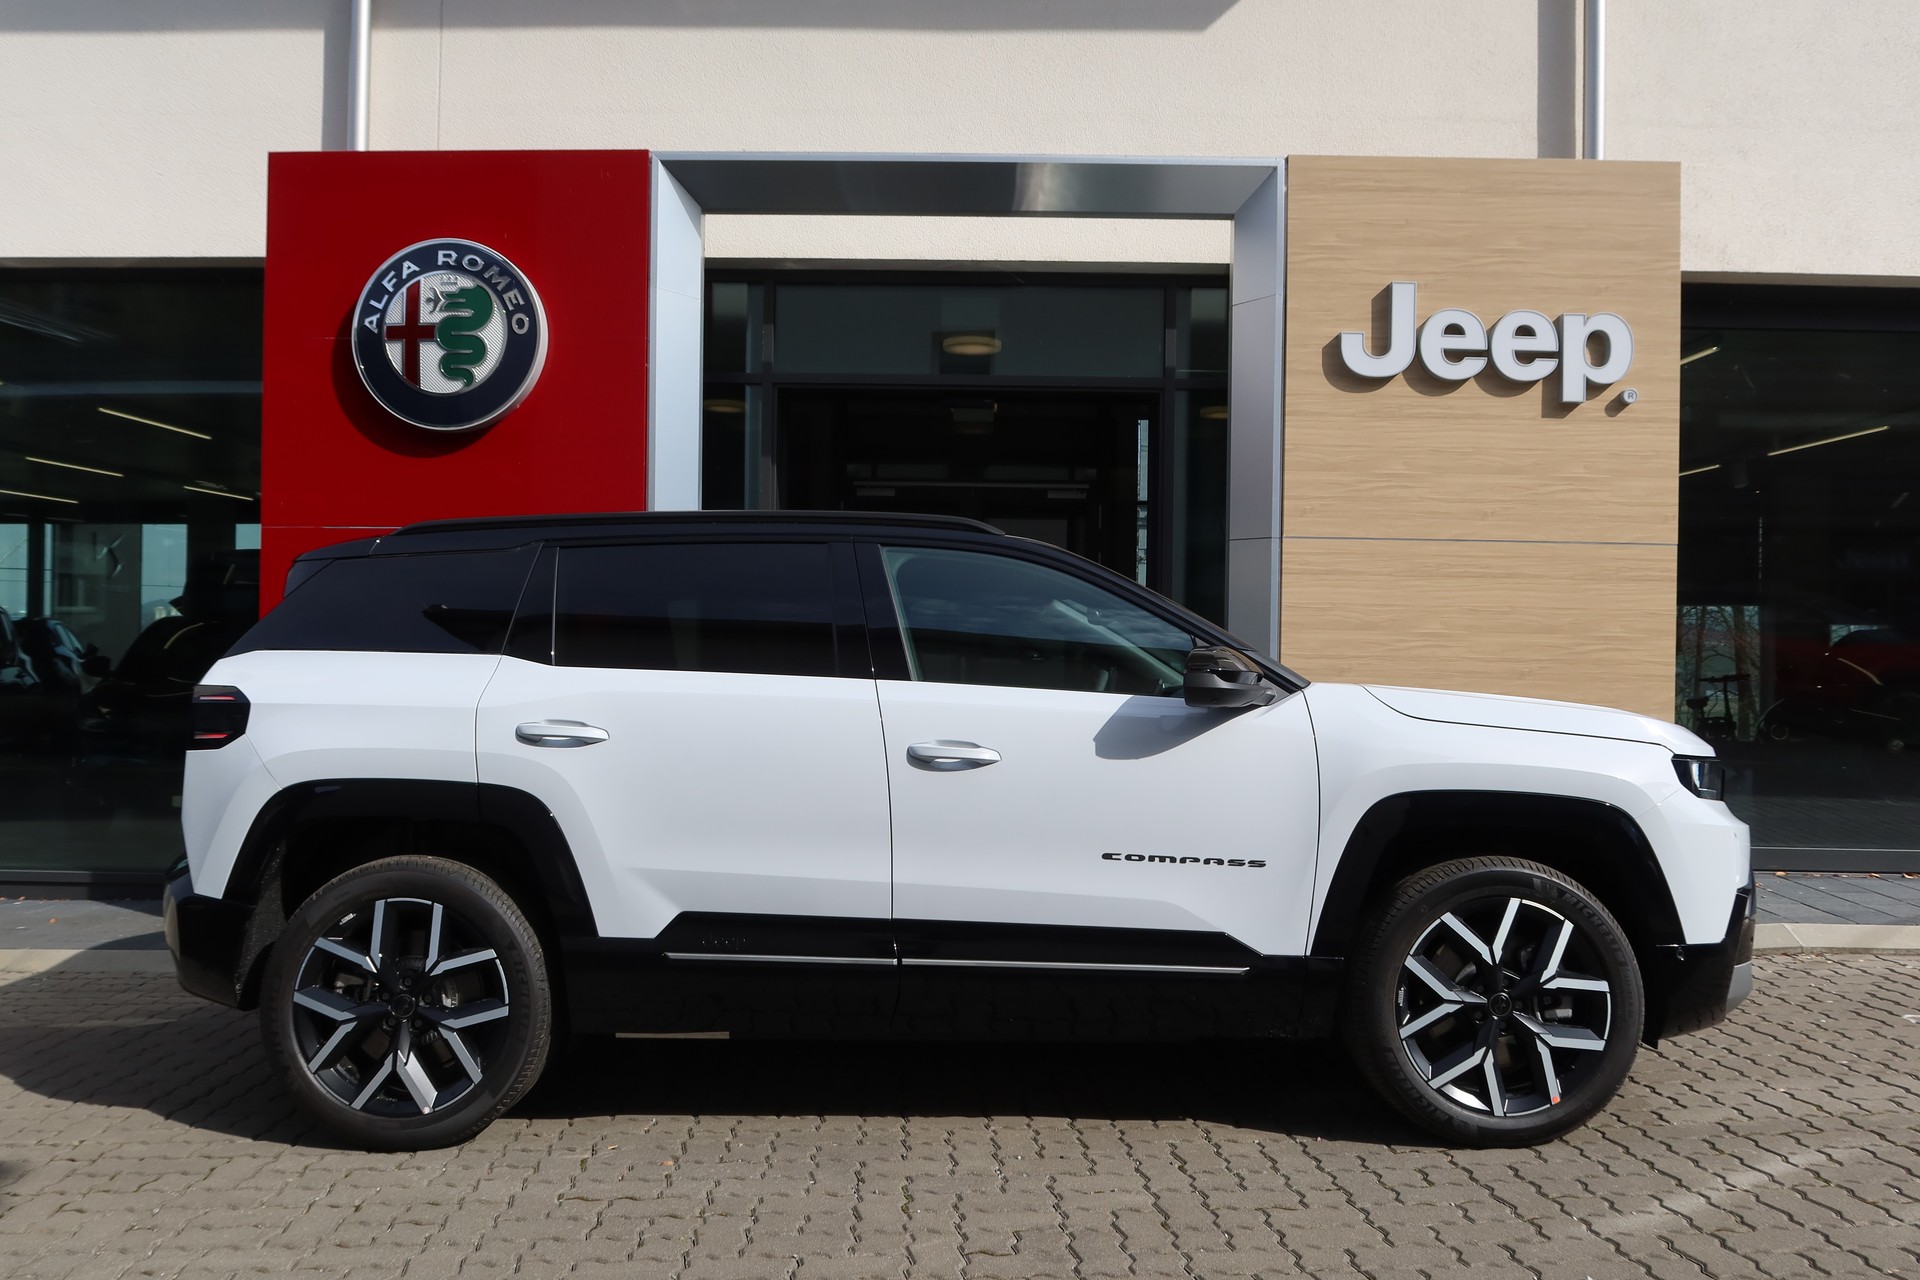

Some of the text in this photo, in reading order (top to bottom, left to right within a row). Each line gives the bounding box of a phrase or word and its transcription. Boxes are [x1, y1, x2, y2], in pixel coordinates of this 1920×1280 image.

[364, 250, 530, 335] ALFA ROMEO
[1340, 281, 1635, 403] Jeep
[1101, 852, 1267, 868] COMPASS
[1563, 892, 1627, 962] MICHELIN
